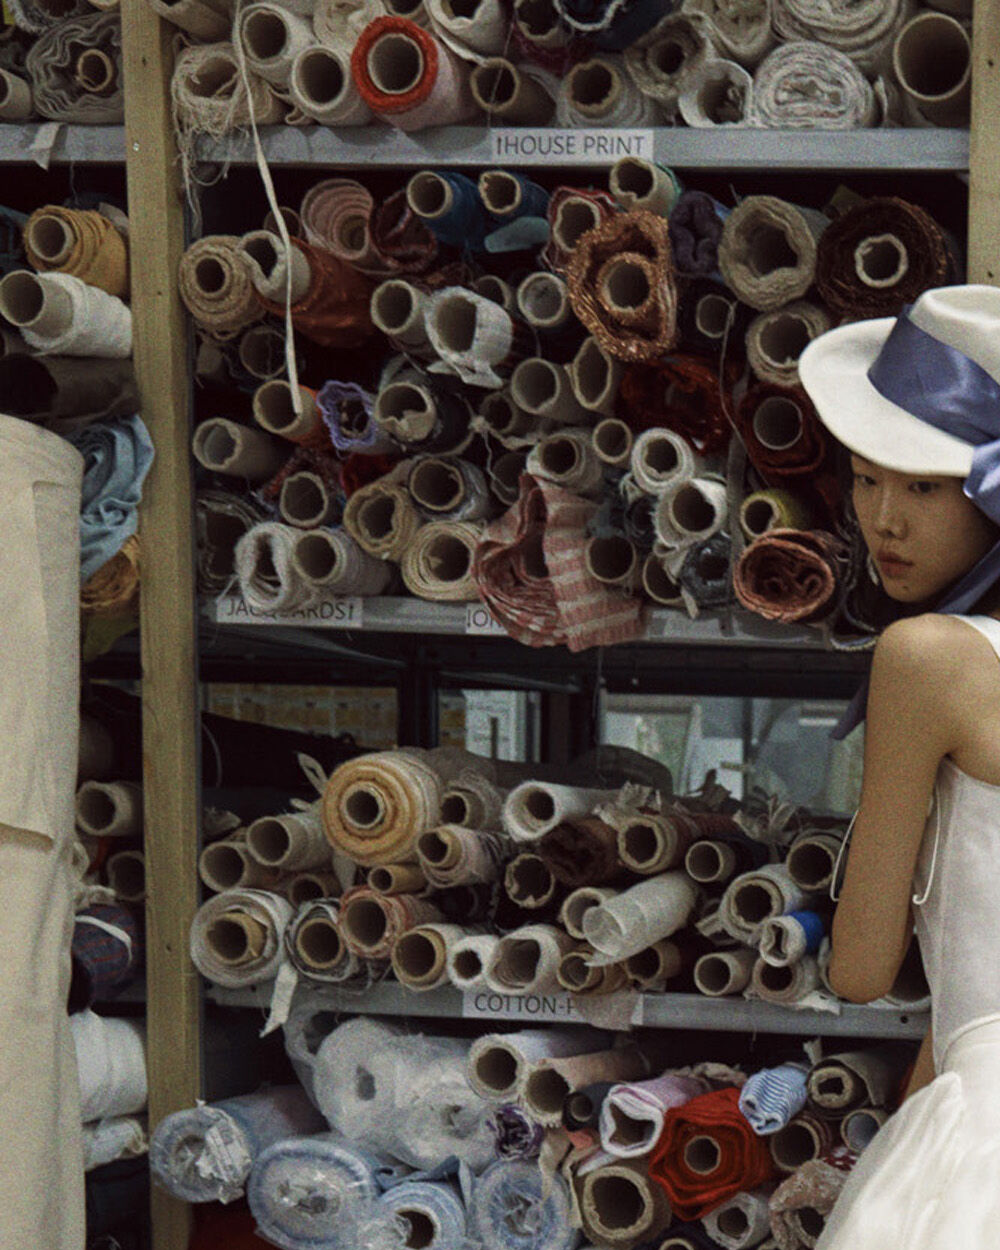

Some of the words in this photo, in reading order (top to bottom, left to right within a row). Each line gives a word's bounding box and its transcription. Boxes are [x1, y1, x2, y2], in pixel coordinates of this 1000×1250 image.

[504, 135, 575, 155] HOUSE
[584, 135, 645, 155] PRINT
[227, 599, 346, 620] JARDS
